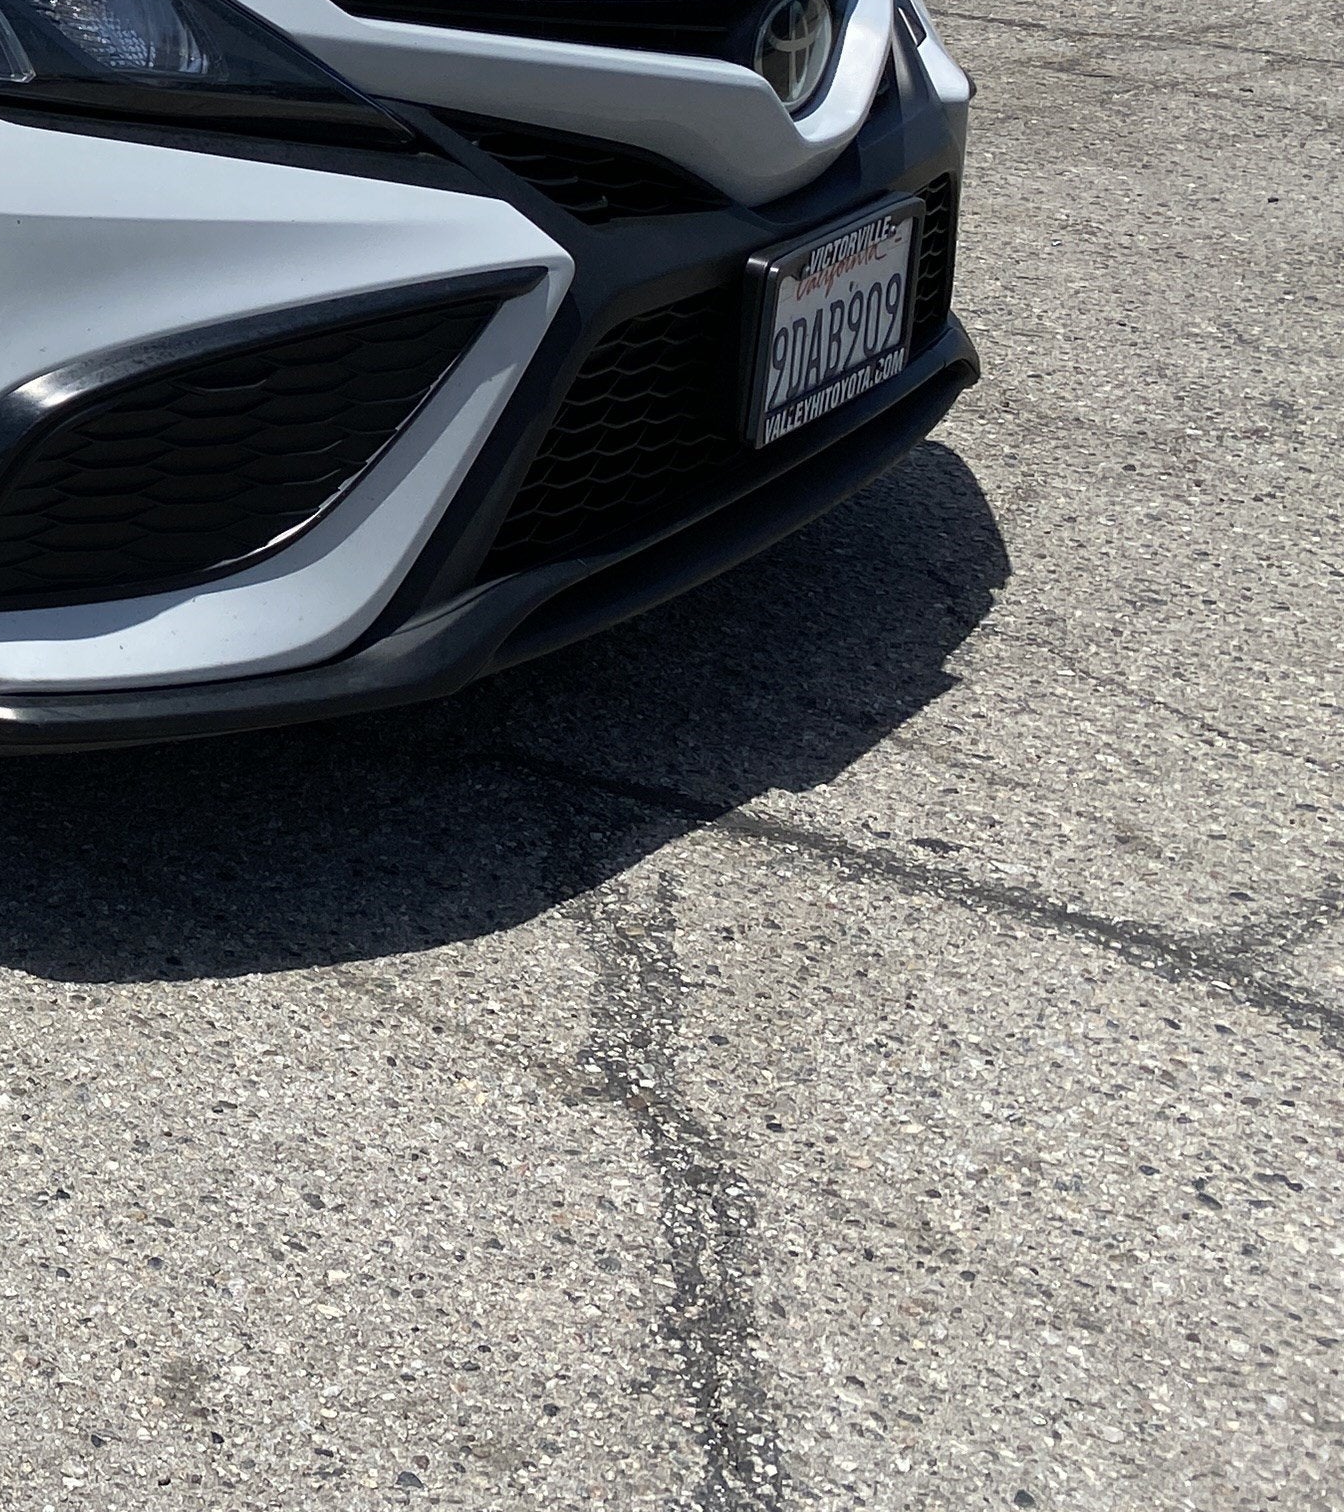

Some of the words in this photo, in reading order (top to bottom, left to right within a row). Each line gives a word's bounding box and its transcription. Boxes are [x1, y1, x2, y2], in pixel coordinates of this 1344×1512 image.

[810, 216, 892, 275] VICTORVILLE
[768, 273, 902, 411] 9DAB909
[764, 348, 905, 445] VALLEYHITOYOTA.COM
